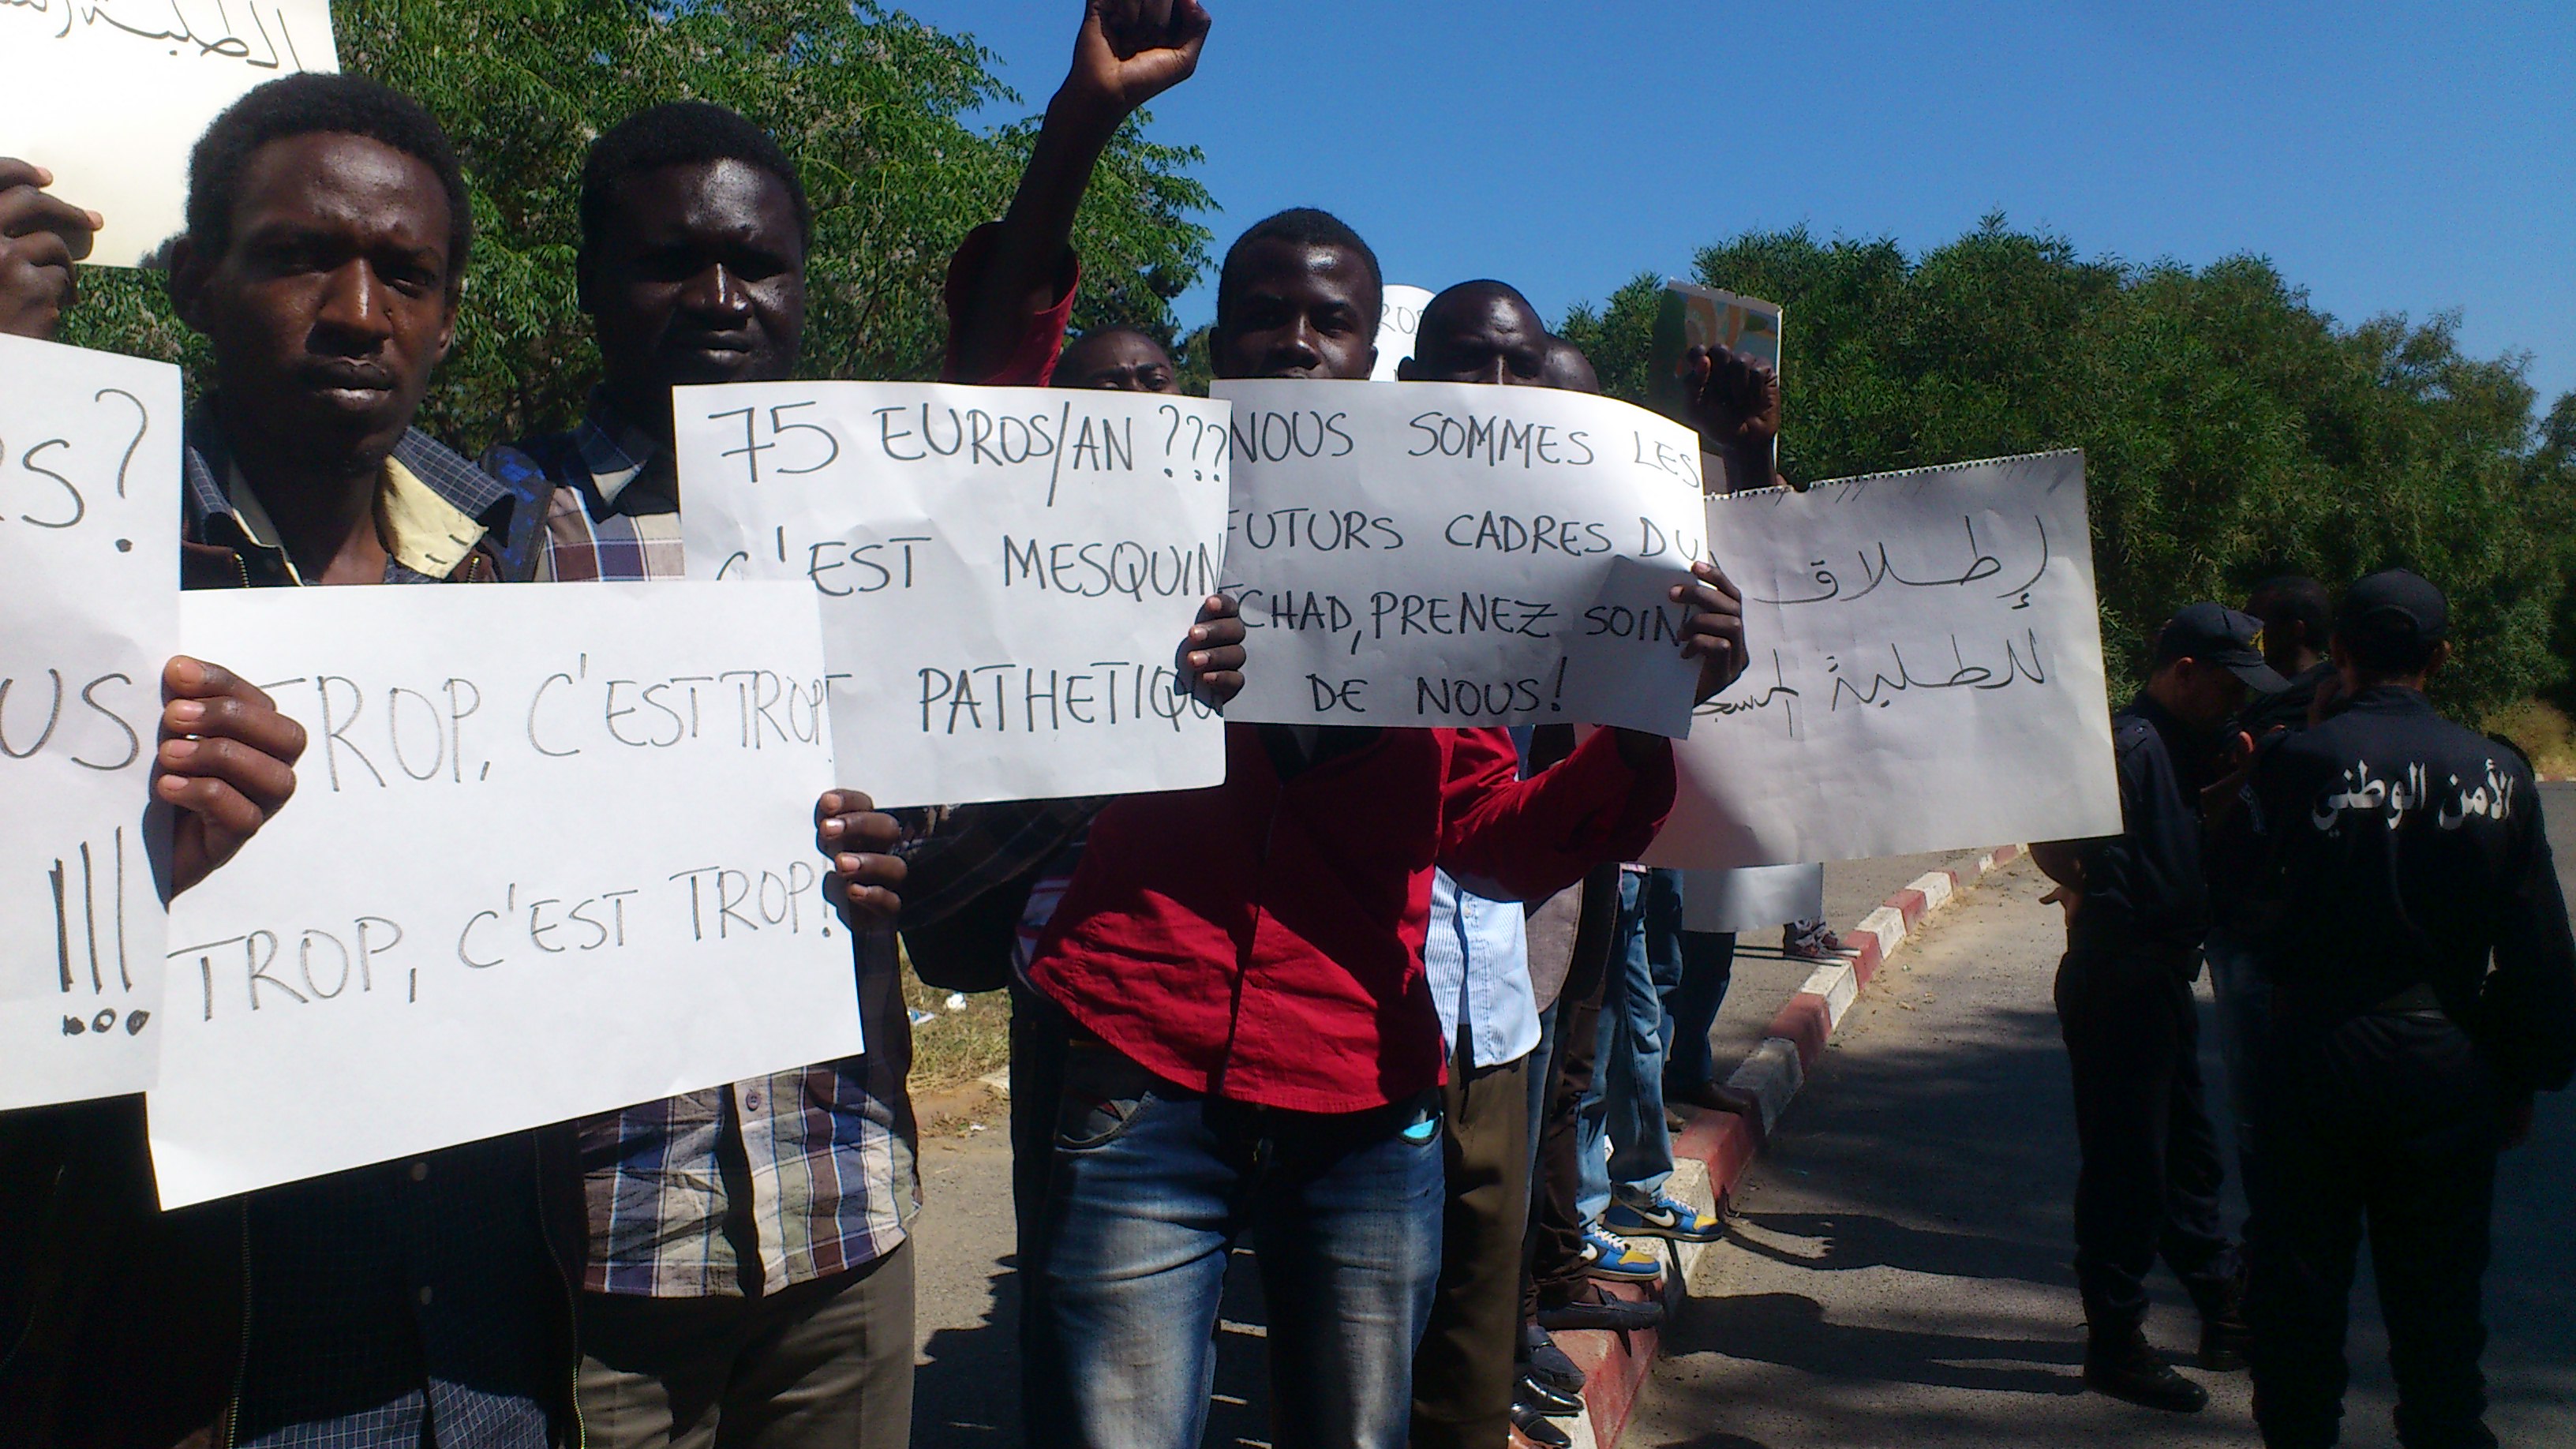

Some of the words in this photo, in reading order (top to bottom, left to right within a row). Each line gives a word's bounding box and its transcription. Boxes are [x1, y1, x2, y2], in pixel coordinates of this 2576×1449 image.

[708, 401, 839, 483] 75
[872, 401, 1133, 507] EUROS/AN
[1159, 404, 1227, 483] ???
[1408, 410, 1594, 468] SOMMES
[1634, 431, 1702, 489] LES
[1004, 534, 1222, 602] MESQUIN
[1446, 510, 1612, 558] CADRES
[1640, 516, 1698, 560] DU
[1585, 603, 1690, 646] SOIN
[1307, 673, 1367, 713] DE
[1417, 657, 1567, 716] NOUS!
[2312, 759, 2426, 837] الوطني
[2439, 757, 2514, 829] الأمن
[167, 916, 417, 1022] TROP,
[458, 882, 638, 969] C'EST
[669, 860, 832, 939] TROP!
